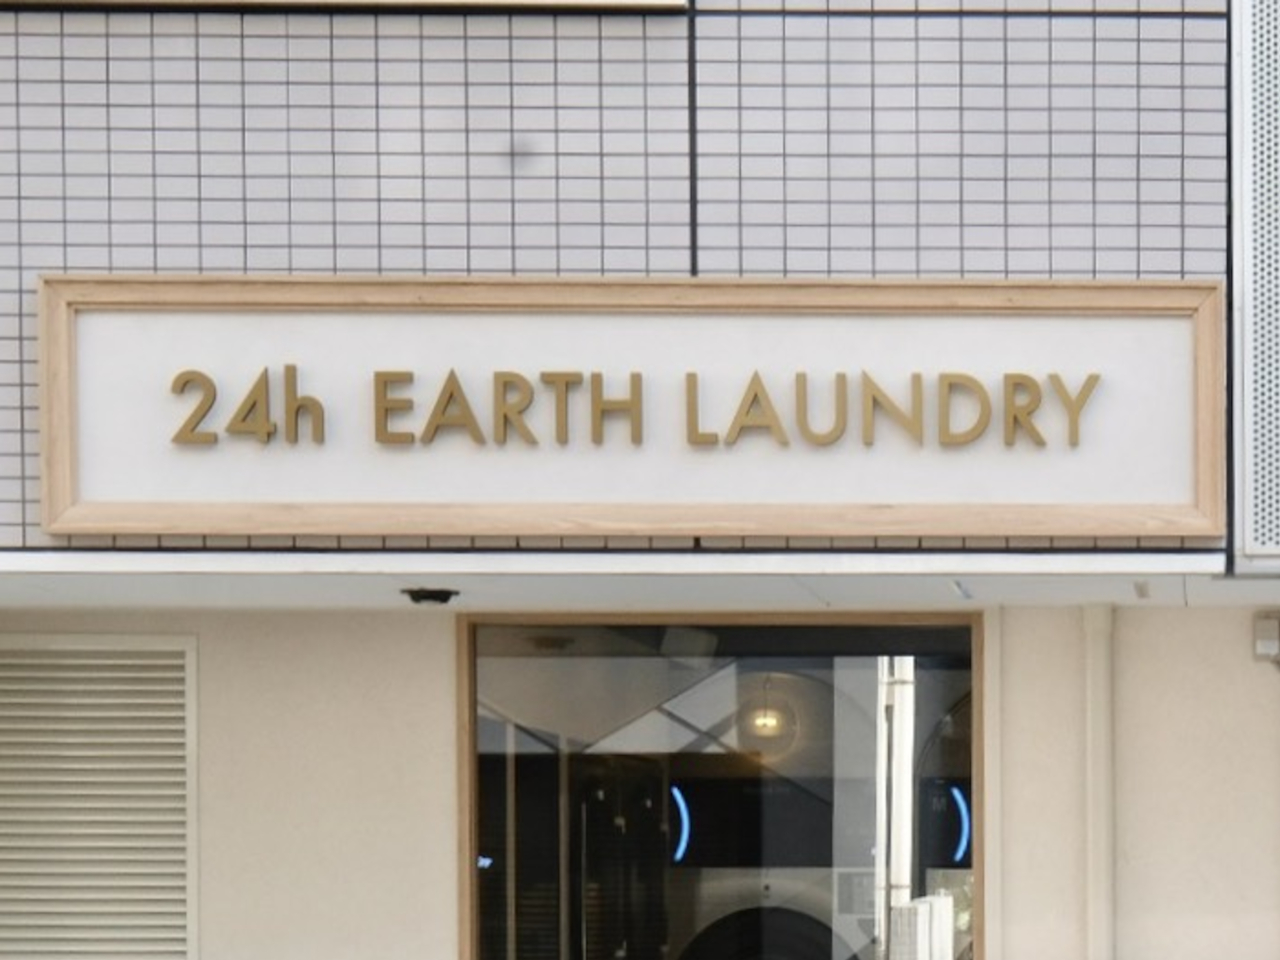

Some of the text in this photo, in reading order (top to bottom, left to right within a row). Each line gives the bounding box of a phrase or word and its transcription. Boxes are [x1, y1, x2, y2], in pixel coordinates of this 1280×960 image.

[169, 364, 1103, 449] 24h EARTH LAUNDRY
